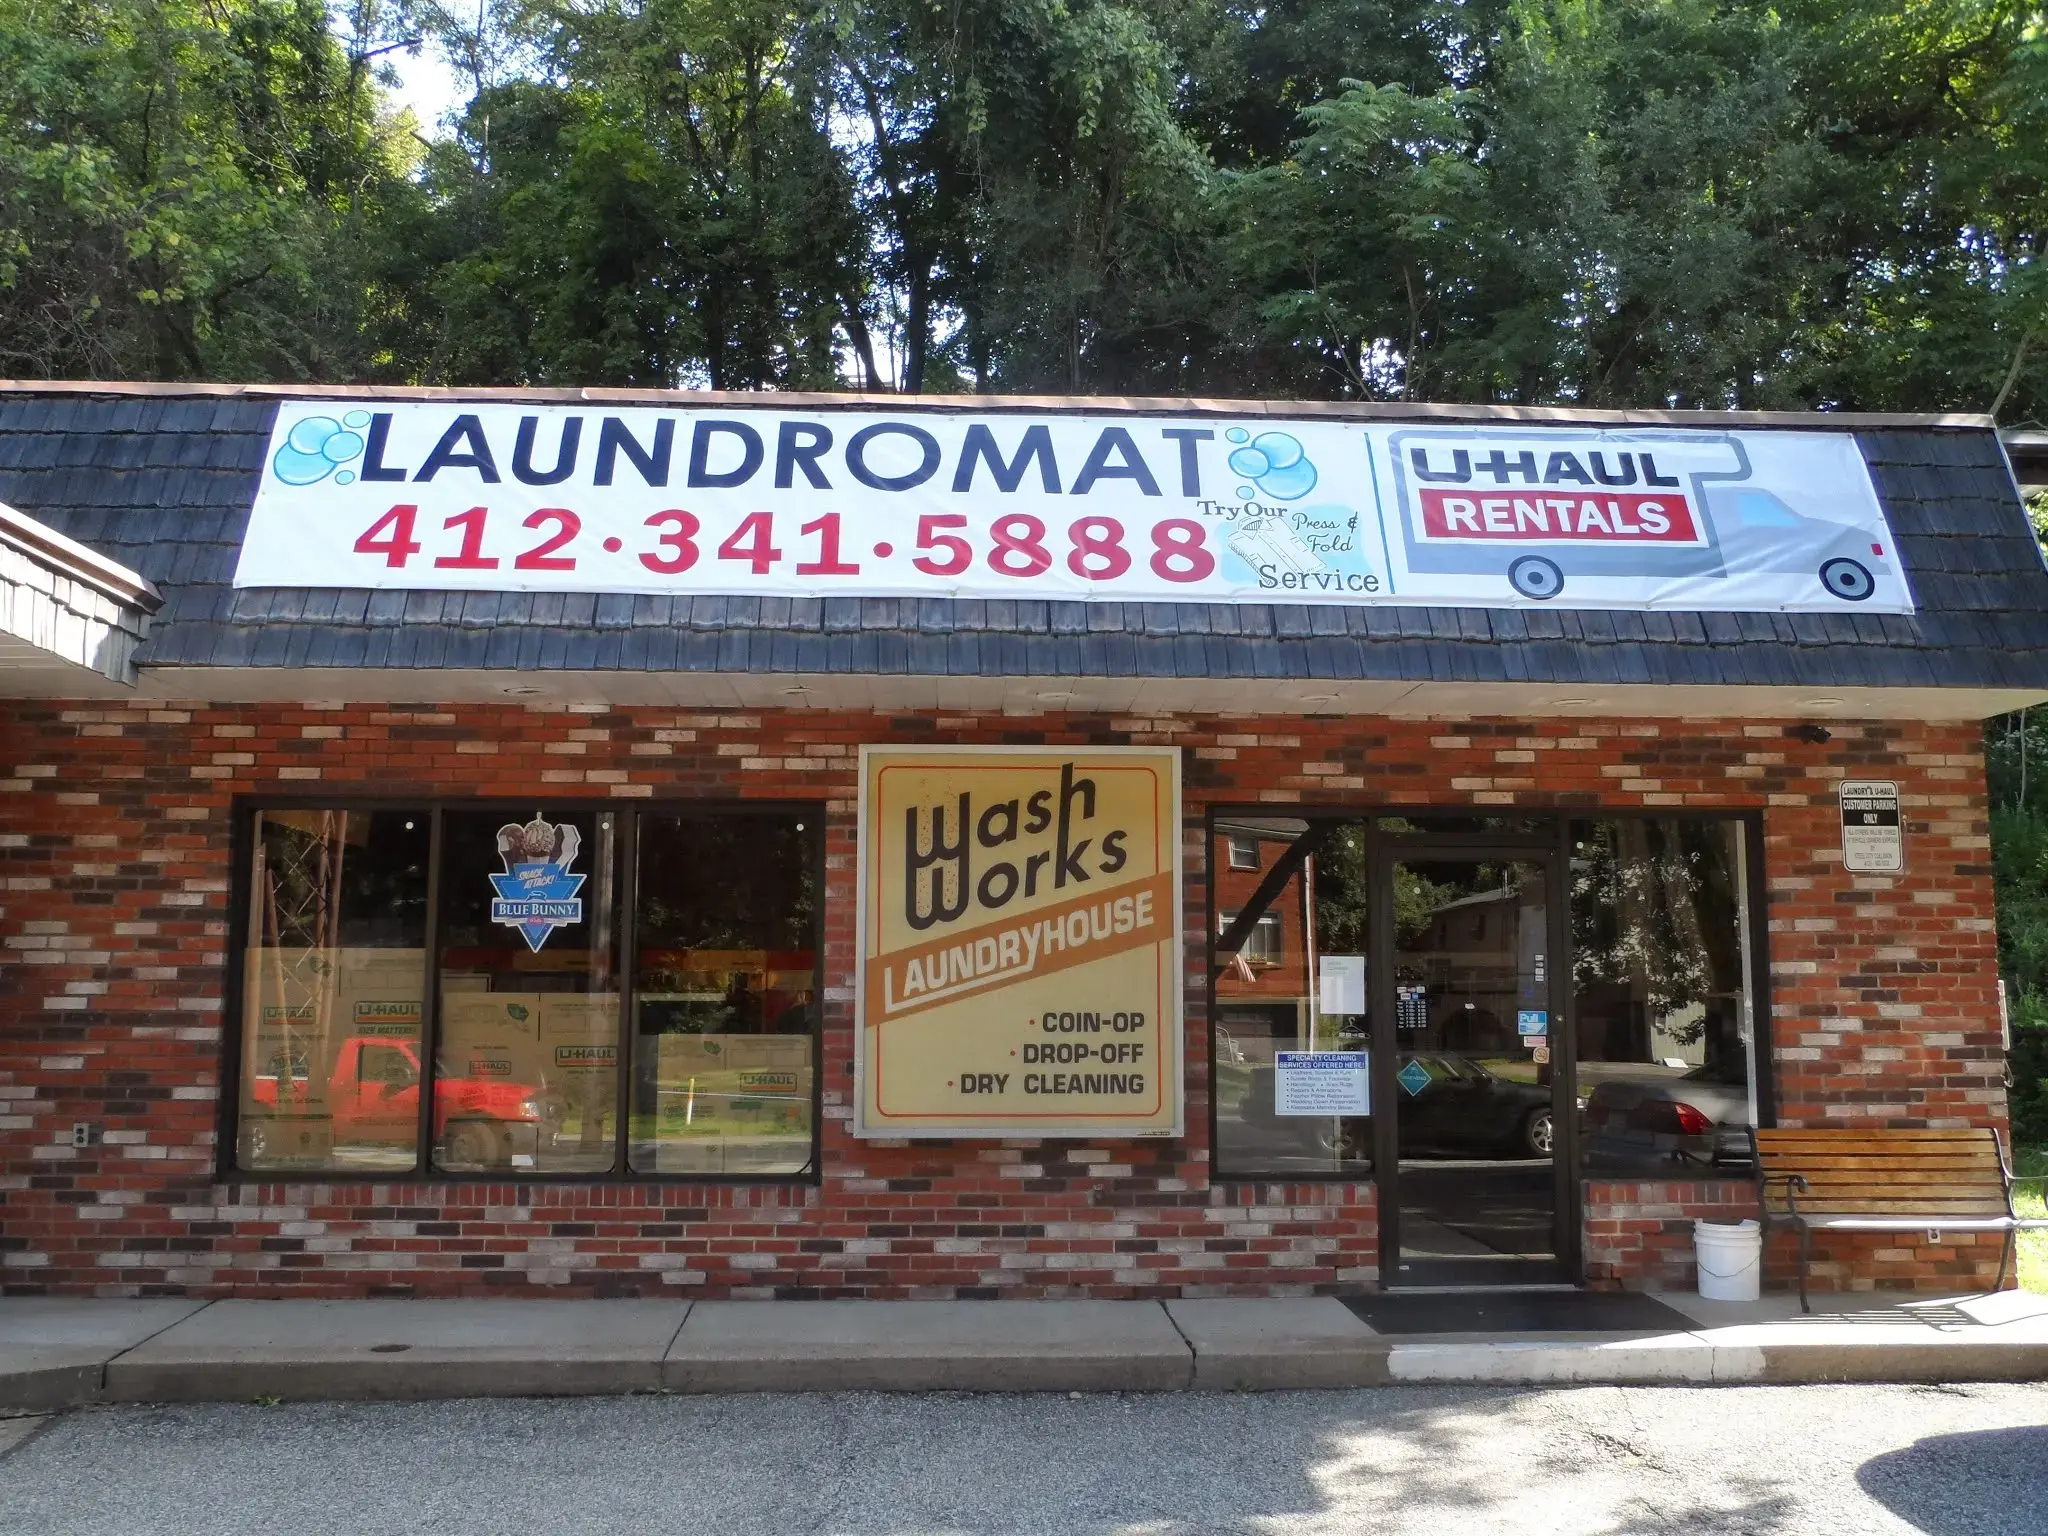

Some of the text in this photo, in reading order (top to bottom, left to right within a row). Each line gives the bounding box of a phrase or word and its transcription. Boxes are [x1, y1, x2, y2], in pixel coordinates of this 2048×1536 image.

[360, 412, 1215, 498] LAUNDROMAT
[1411, 447, 1680, 487] U-HAUL
[1197, 500, 1288, 521] Try Our
[1442, 497, 1671, 535] RENTALS
[1291, 512, 1341, 531] Press
[1306, 533, 1353, 553] Fold
[1258, 563, 1380, 592] Service
[1875, 787, 1894, 796] U-HAUL
[1843, 799, 1897, 810] CUSTOMER PARKING
[905, 762, 1097, 868] Wash
[1863, 813, 1878, 824] ONLY
[524, 875, 555, 889] ATTACK!
[905, 830, 1128, 930] Works
[499, 903, 529, 915] BLUE
[359, 1004, 419, 1015] U-HAUL
[1519, 1013, 1539, 1023] Pull
[1042, 1012, 1145, 1033] COIN-OP
[559, 1049, 614, 1059] U-HAUL
[1023, 1043, 1144, 1064] DROP-OFF
[743, 1075, 794, 1085] U-HAUL
[960, 1073, 1144, 1095] DRY CLEANING
